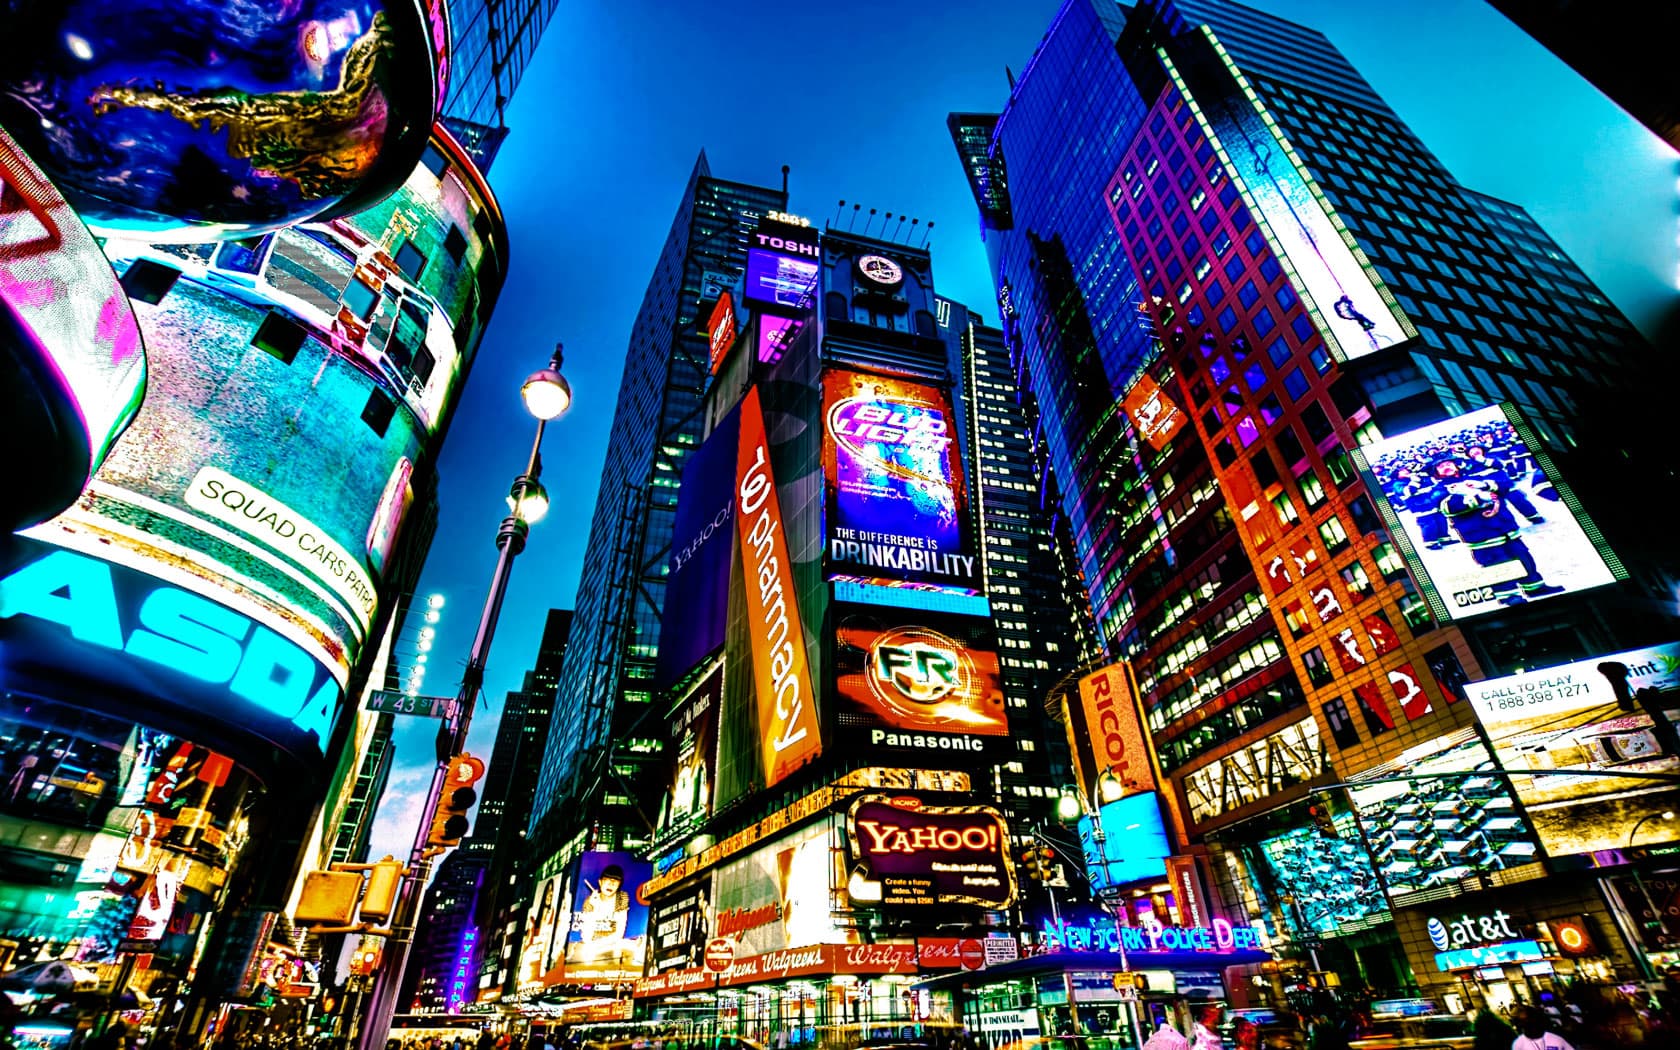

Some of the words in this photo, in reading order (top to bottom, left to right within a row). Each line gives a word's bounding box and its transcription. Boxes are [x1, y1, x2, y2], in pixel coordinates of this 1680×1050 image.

[199, 479, 296, 539] SQUAD
[298, 532, 347, 579] CARS
[674, 499, 732, 574] YAHOO!
[836, 527, 856, 540] THE
[859, 530, 924, 549] DIFFERENCE
[927, 537, 938, 550] IS
[831, 538, 974, 578] DRINKABILITY
[1454, 587, 1496, 607] 002
[747, 507, 808, 753] pharmacy
[1481, 683, 1512, 701] CALL
[1518, 682, 1535, 693] TO
[1539, 674, 1573, 691] PLAY
[1488, 701, 1494, 712] 1
[1499, 695, 1525, 710] 888
[1528, 689, 1553, 705] 398
[1558, 683, 1591, 699] 1271
[371, 693, 388, 709] W
[392, 696, 416, 713] 43
[420, 698, 434, 708] ST
[871, 729, 984, 752] Panasonic
[858, 821, 998, 853] YAHOO!
[1147, 917, 1212, 952] POLICE
[1450, 909, 1518, 945] at&t
[761, 947, 826, 976] Walgreens
